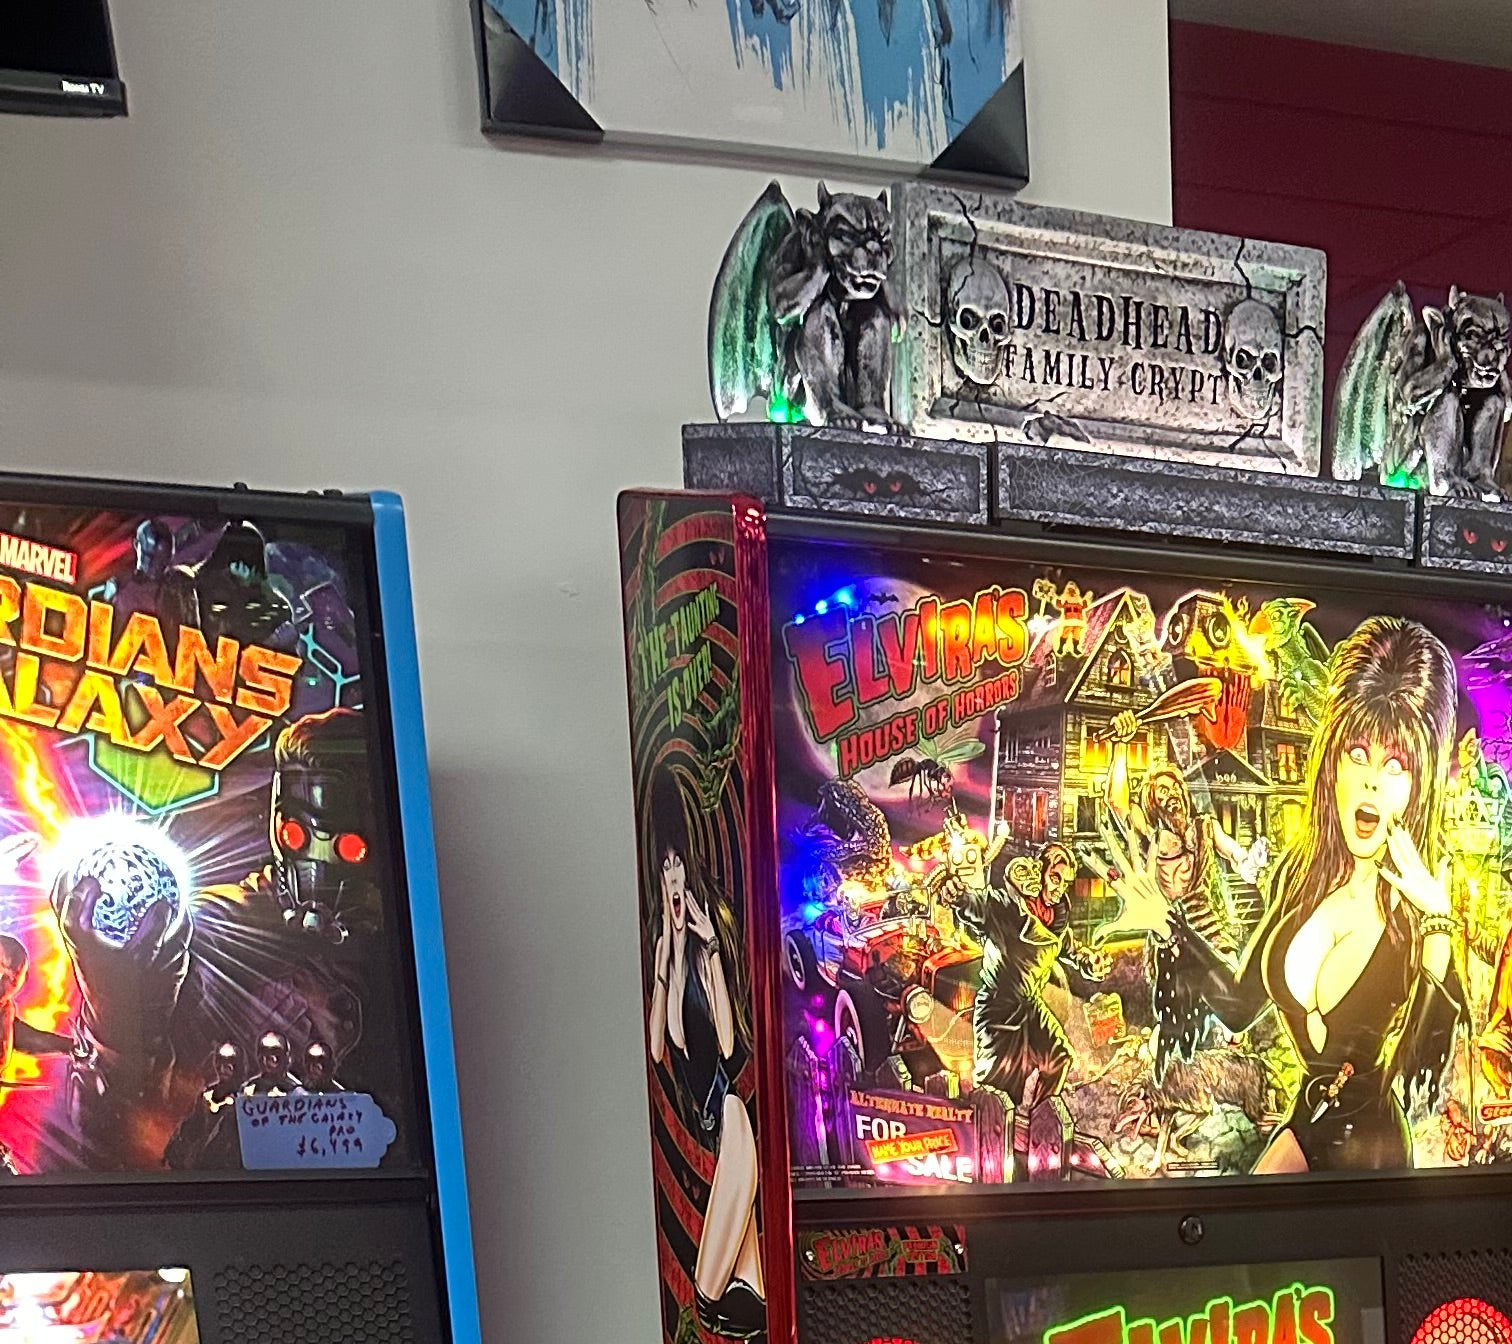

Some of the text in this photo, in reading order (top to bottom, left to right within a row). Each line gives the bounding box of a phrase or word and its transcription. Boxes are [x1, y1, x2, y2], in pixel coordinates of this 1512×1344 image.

[1014, 283, 1223, 355] DEADHEAD
[1004, 344, 1221, 406] FAMILY CRYPT
[1, 536, 75, 583] MARVEL
[637, 623, 668, 690] THE
[667, 677, 681, 733] IS
[836, 669, 1019, 779] HOUSE OF HORRORS
[242, 1098, 348, 1116] GUARDIANS
[850, 1090, 924, 1117] ALTERNATE
[251, 1116, 269, 1127] OF
[278, 1112, 306, 1125] THE
[329, 1125, 355, 1136] PRO
[856, 1114, 906, 1140] FOR
[872, 1134, 951, 1158] NAME YOUR PRICE
[908, 1153, 973, 1183] SALE
